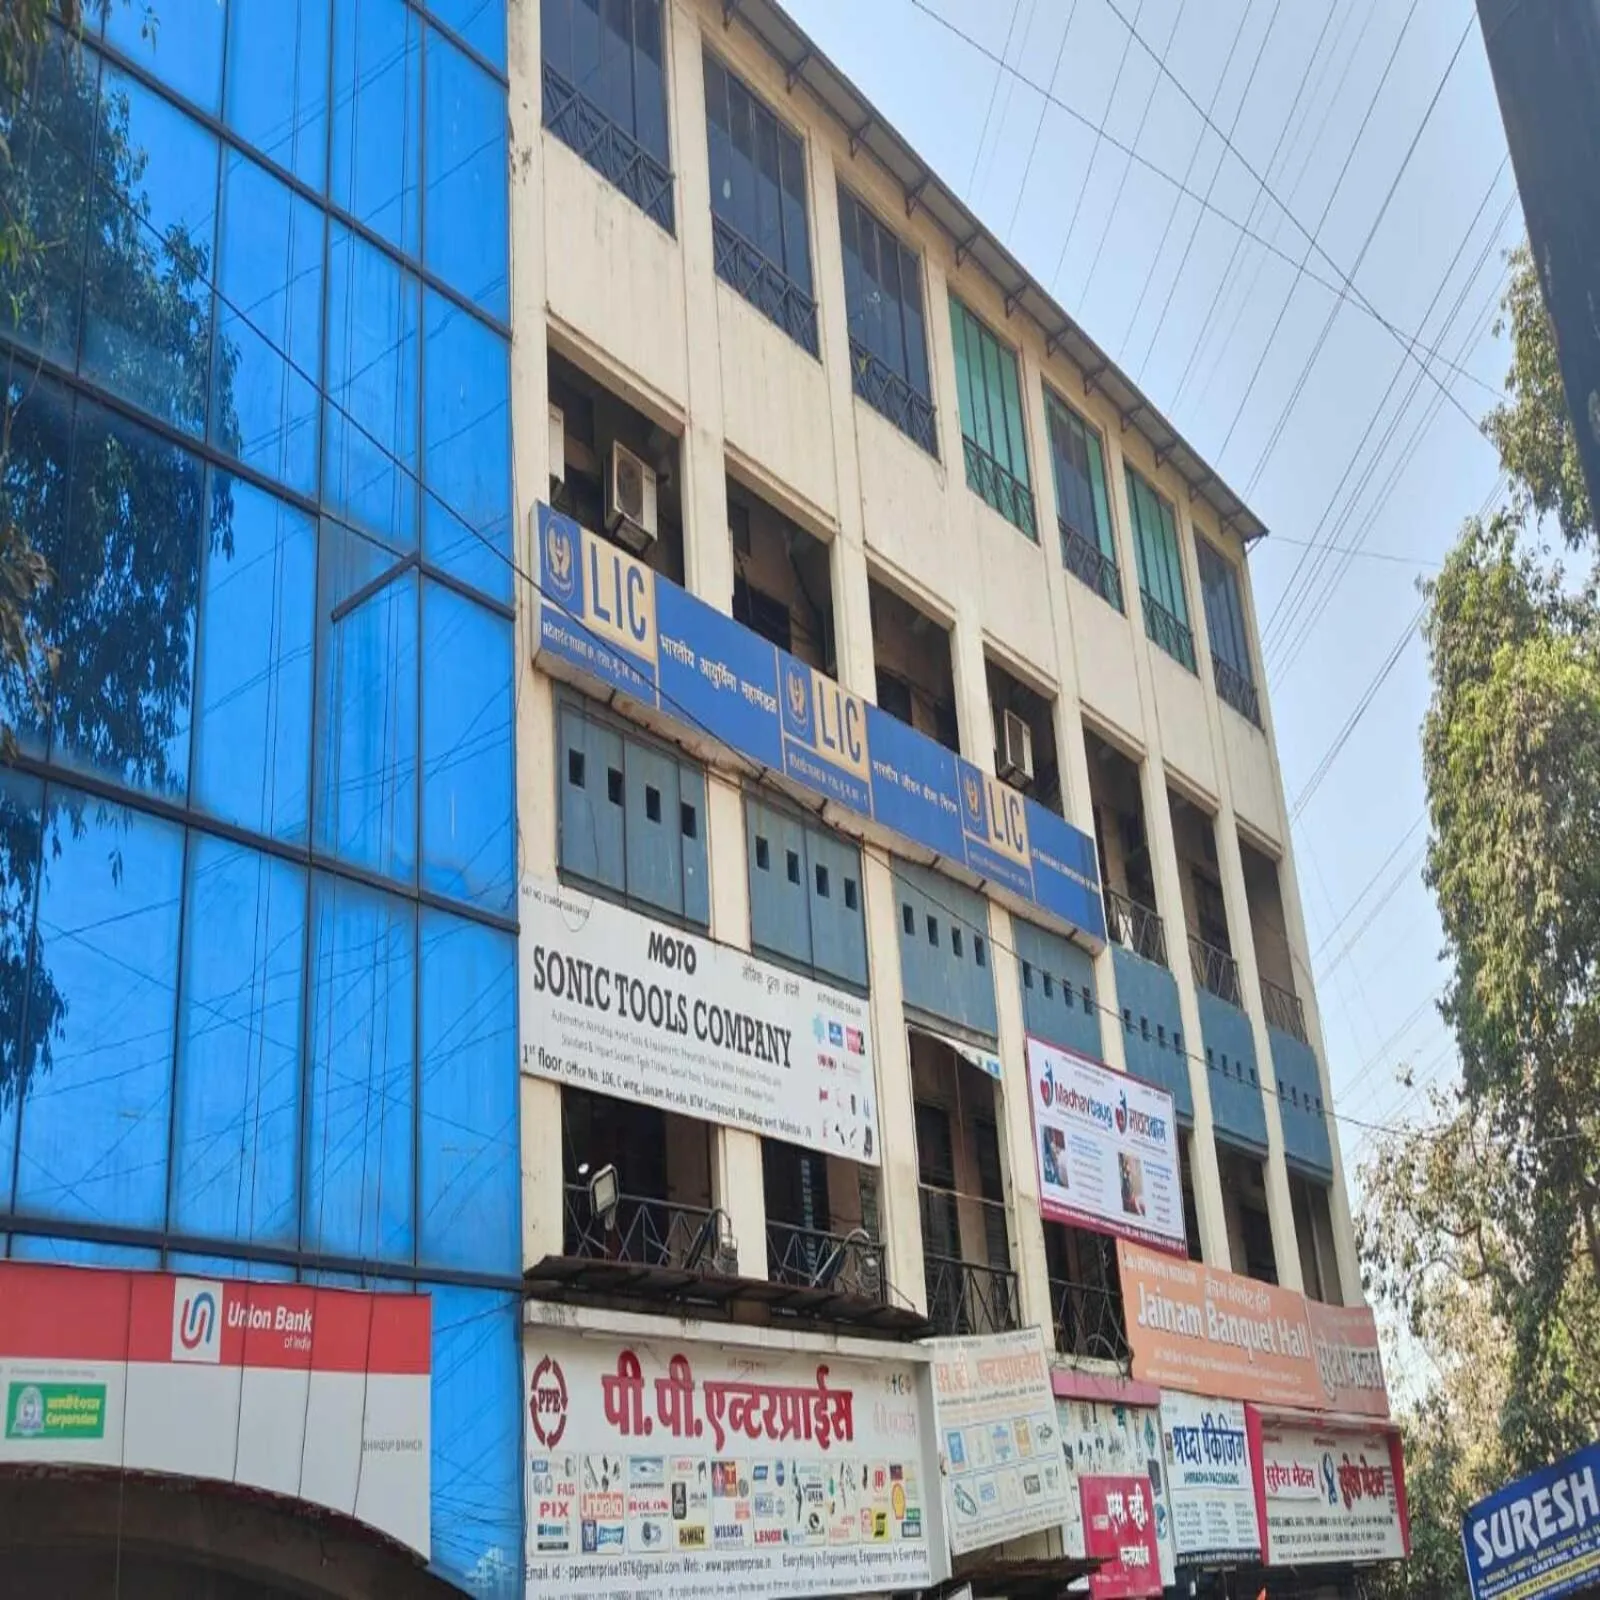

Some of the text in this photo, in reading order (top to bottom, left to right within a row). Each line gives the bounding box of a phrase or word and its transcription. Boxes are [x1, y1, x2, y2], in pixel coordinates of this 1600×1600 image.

[589, 541, 646, 643] LIC
[660, 633, 695, 669] भारतीय
[818, 681, 861, 763] LIC
[988, 782, 1024, 854] LIC
[648, 930, 698, 976] MOTO
[533, 944, 611, 1013] SONIC
[614, 971, 689, 1037] TOOLS
[693, 1000, 792, 1069] COMPANY
[1054, 1081, 1113, 1129] Madhavbaug
[227, 1300, 313, 1334] Union Bank
[1137, 1281, 1312, 1362] Jainam Banquet Hall
[536, 1386, 561, 1415] PPE
[540, 1501, 569, 1518] PIX
[1472, 1465, 1600, 1569] SURESH
